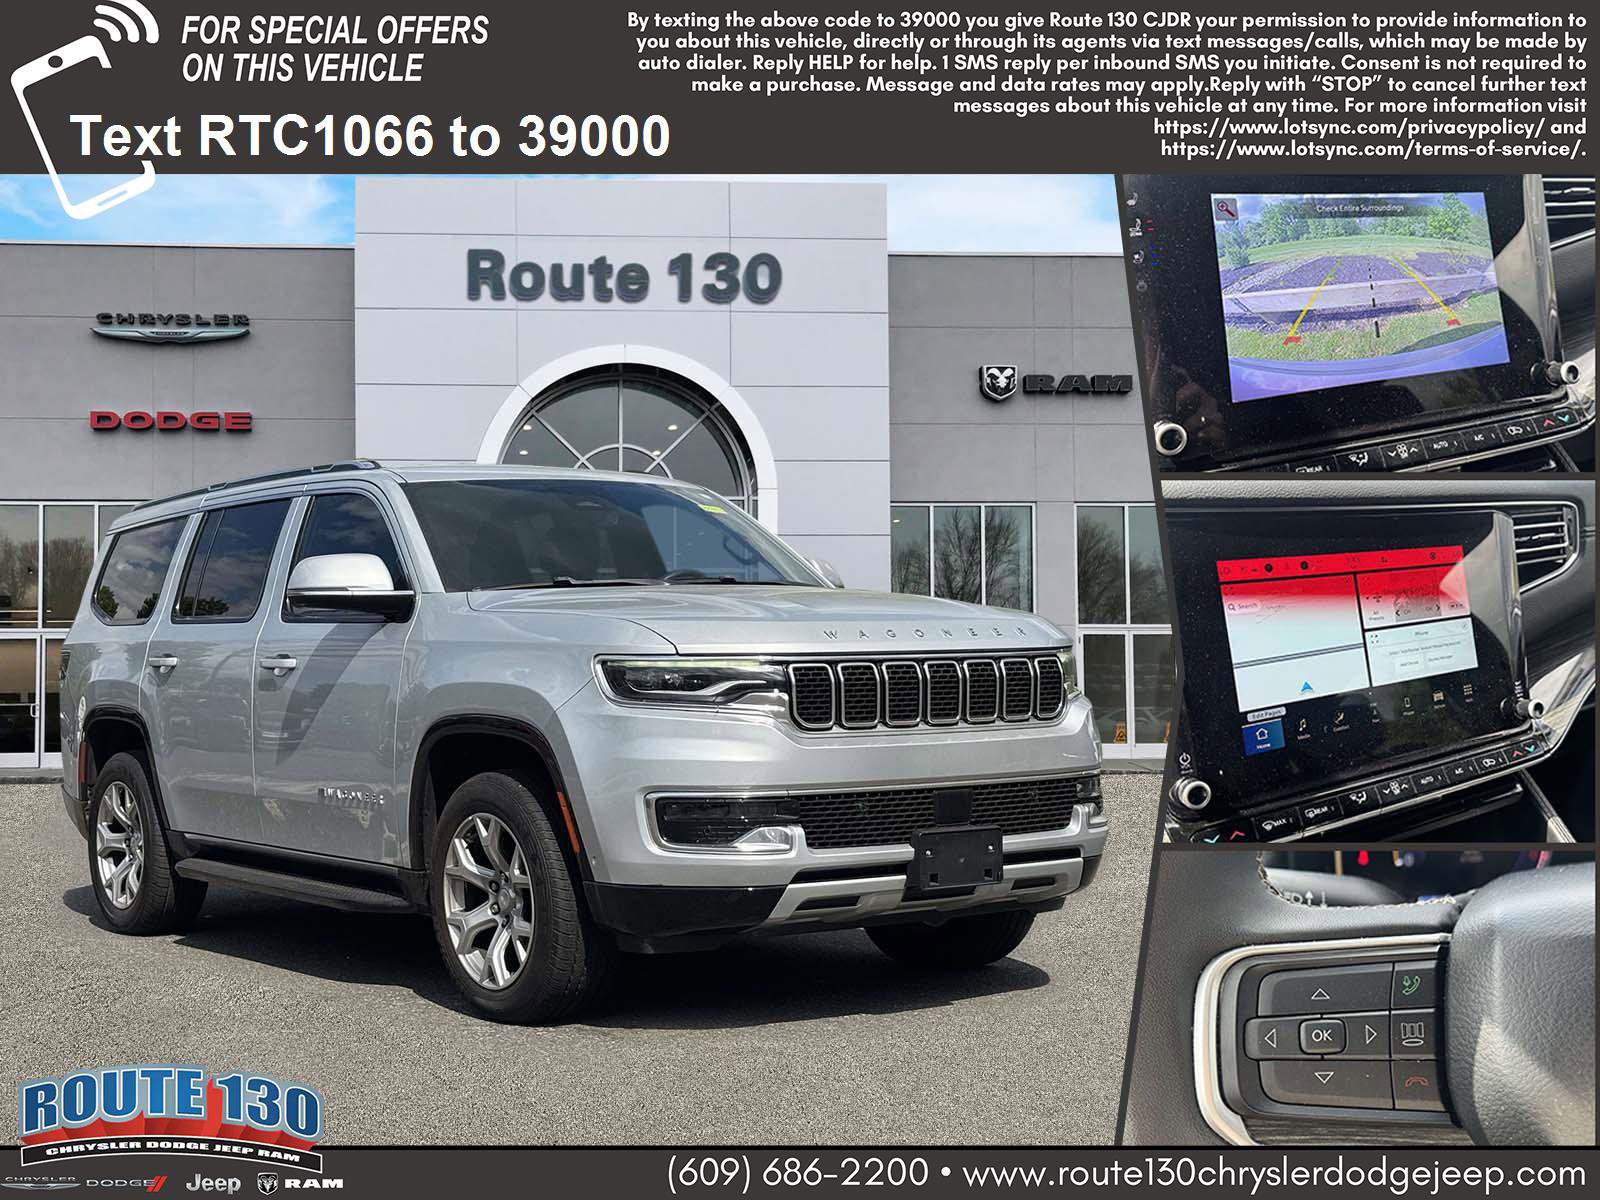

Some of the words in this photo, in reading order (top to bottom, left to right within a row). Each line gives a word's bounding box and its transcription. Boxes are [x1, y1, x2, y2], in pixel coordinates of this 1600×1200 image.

[467, 249, 650, 303] Route
[667, 252, 783, 304] 130
[96, 312, 250, 327] CHRYSLER
[1023, 374, 1134, 394] RAM
[89, 410, 252, 432] DODGE
[823, 626, 1027, 640] WAGONEER
[1312, 1029, 1333, 1042] OK
